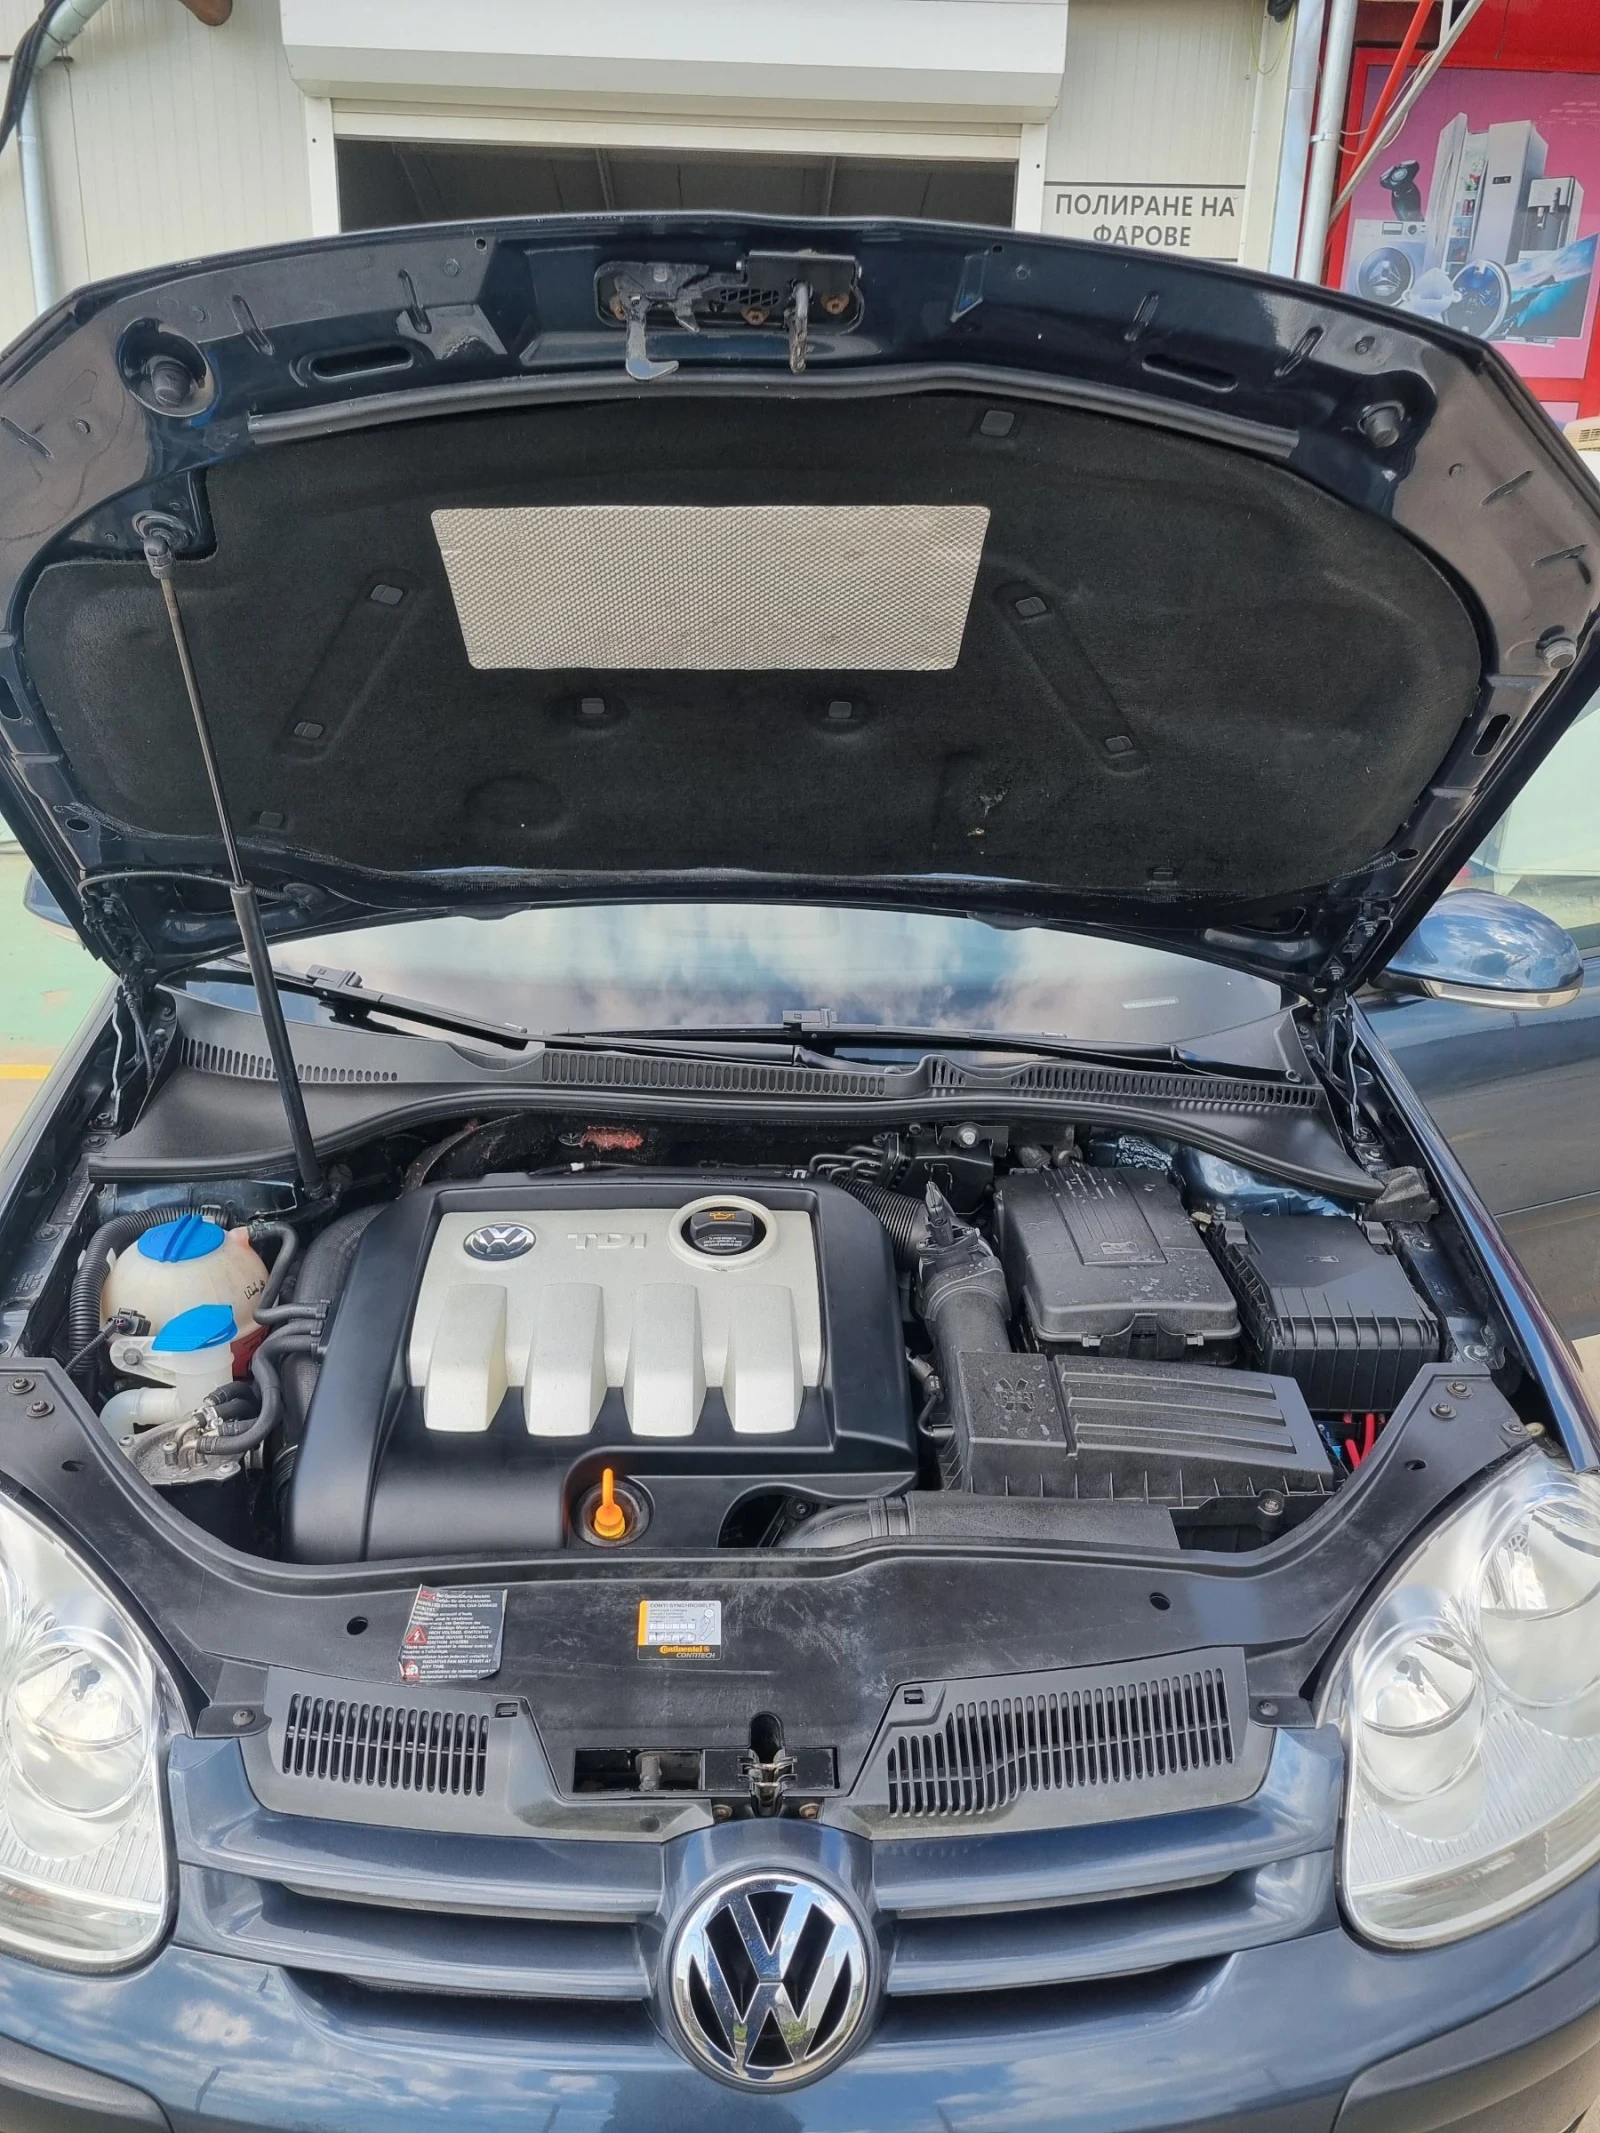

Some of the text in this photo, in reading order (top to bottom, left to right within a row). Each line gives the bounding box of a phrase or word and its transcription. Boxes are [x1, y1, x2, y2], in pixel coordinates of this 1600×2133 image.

[1055, 194, 1236, 217] ПОЛИРАНЕ НА
[1093, 224, 1192, 247] ФАРОВЕ
[567, 1232, 647, 1250] TDI
[660, 1645, 703, 1654] Continental
[671, 1873, 868, 2085] VW
